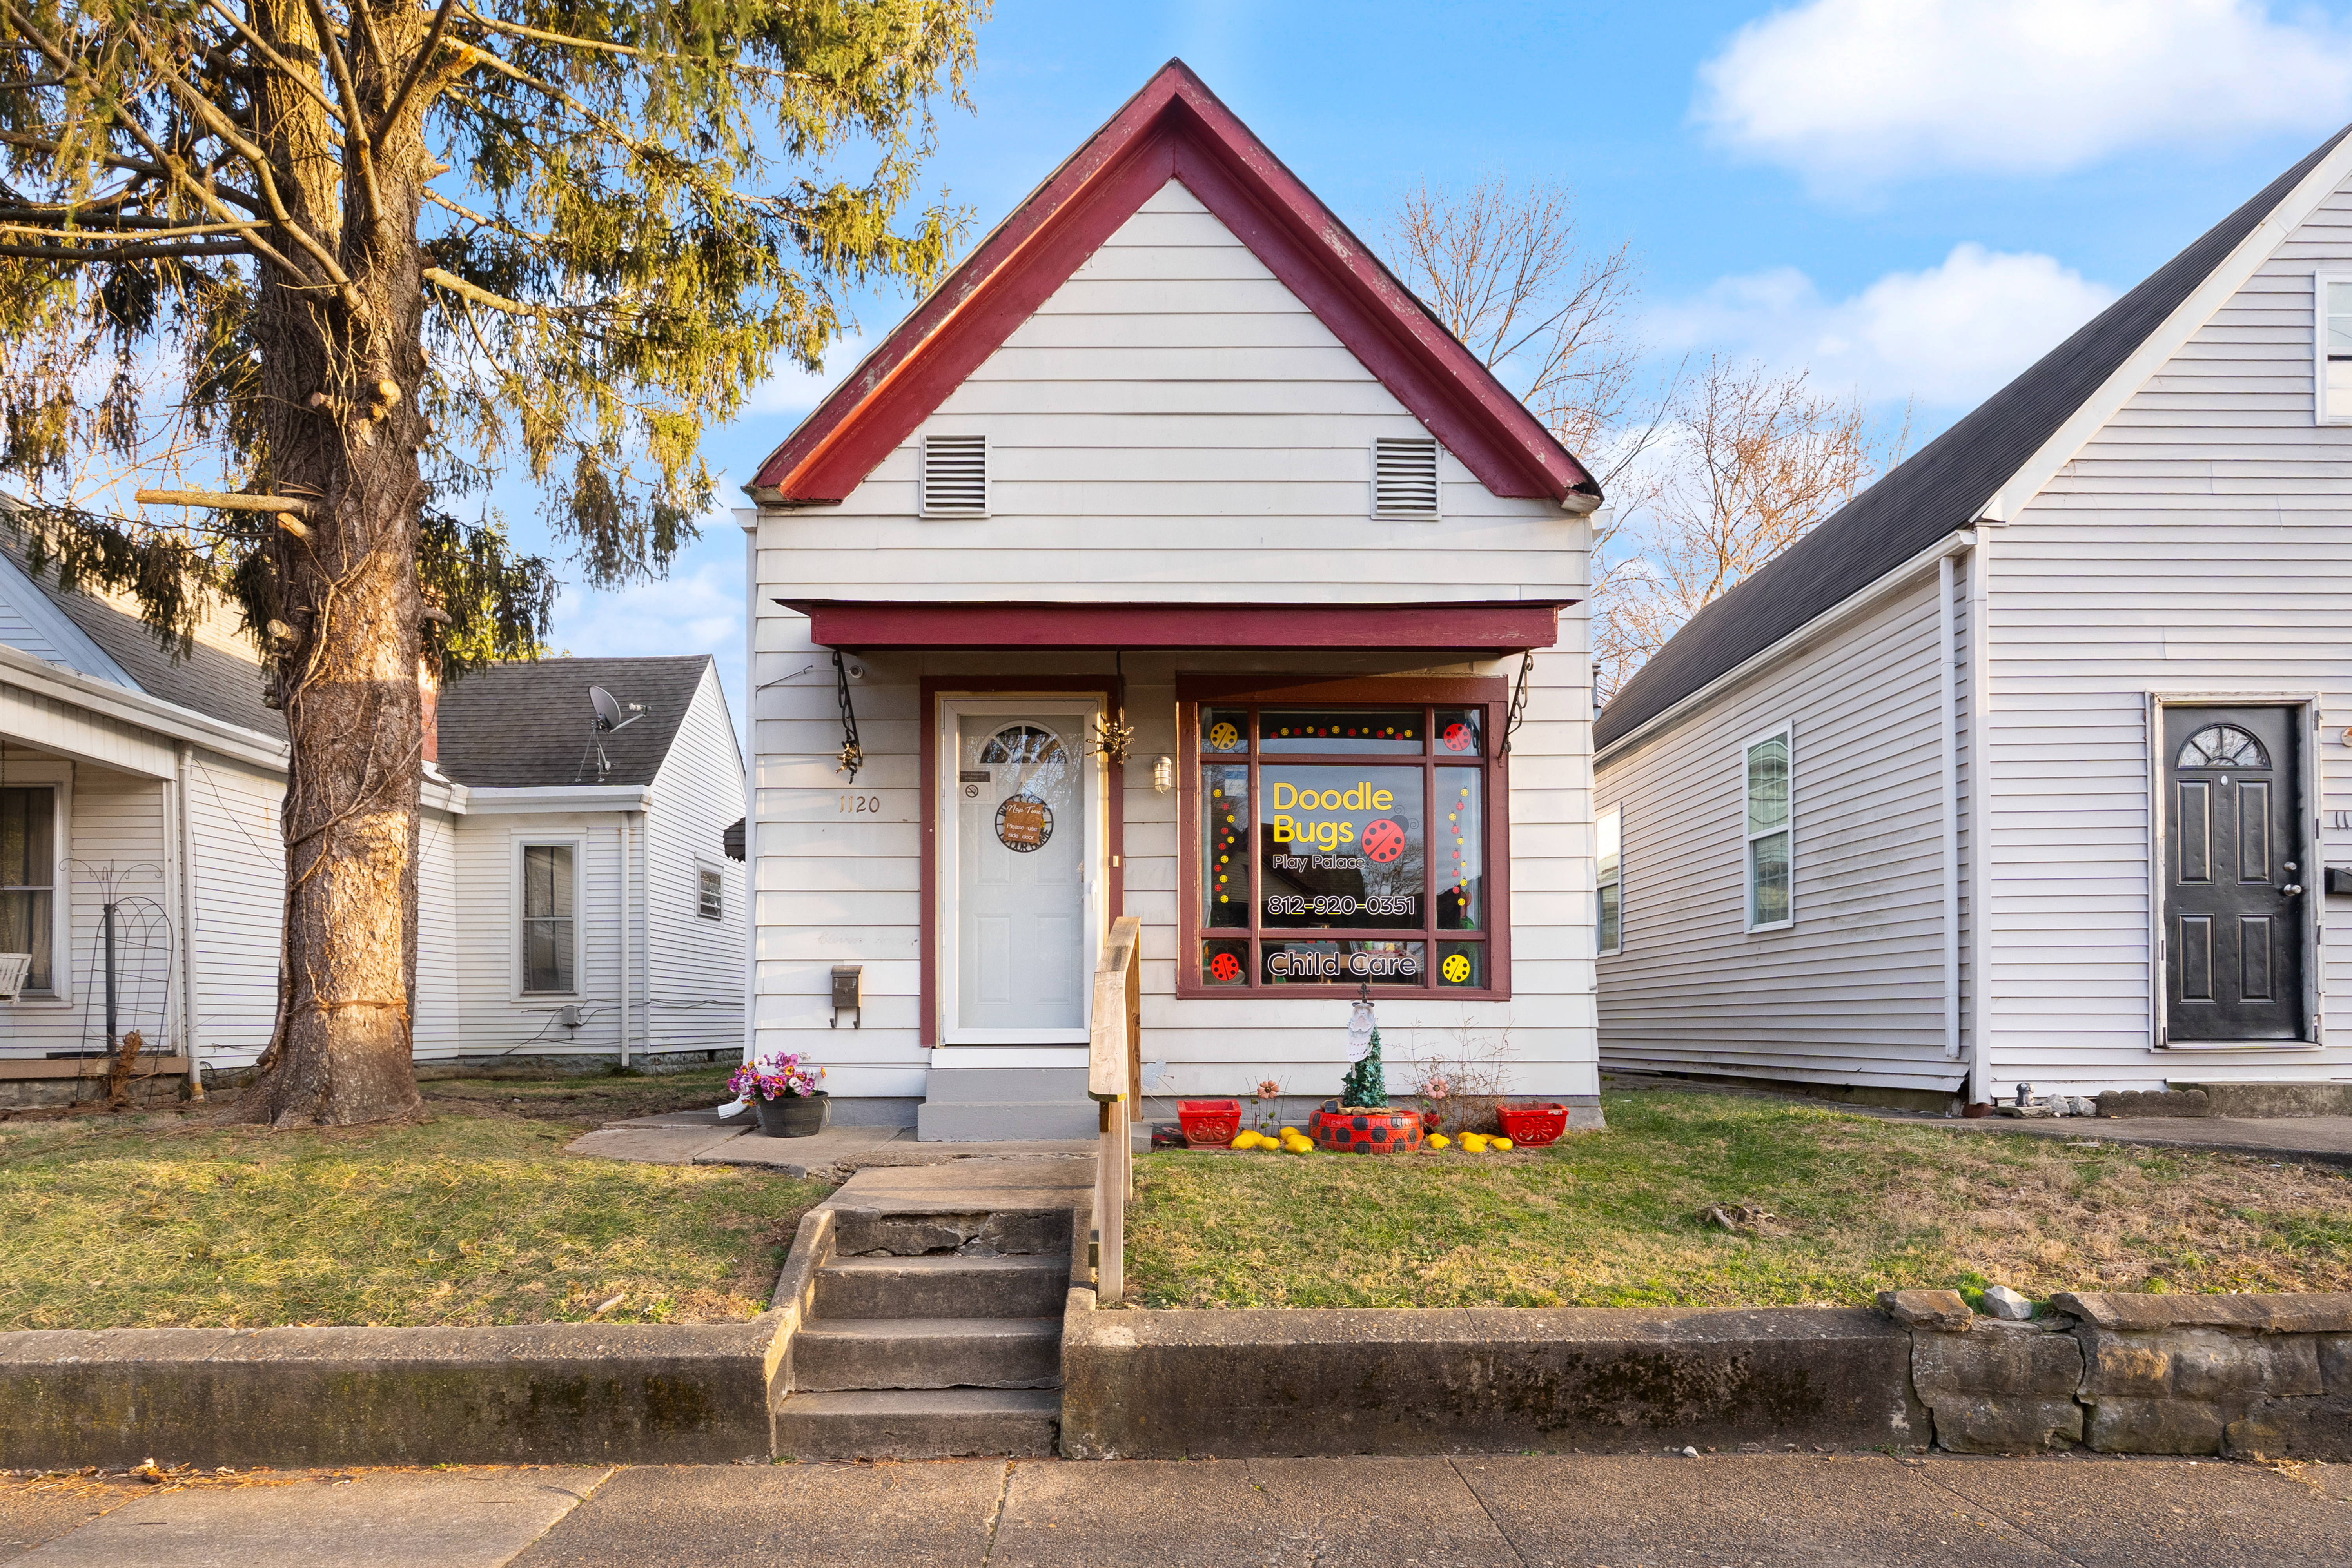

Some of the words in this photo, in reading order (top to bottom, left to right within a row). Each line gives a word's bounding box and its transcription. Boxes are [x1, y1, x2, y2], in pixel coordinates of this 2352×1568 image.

[840, 795, 880, 813] 1120
[1273, 781, 1394, 811] Doodle
[1007, 804, 1024, 814] Nap
[1025, 806, 1041, 815] Time
[1273, 814, 1355, 851] Bugs
[1272, 854, 1308, 873] Play
[1312, 854, 1366, 870] Palace
[1267, 896, 1415, 915] 812-920-0351
[1267, 951, 1340, 976] Child
[1348, 952, 1417, 976] Care
